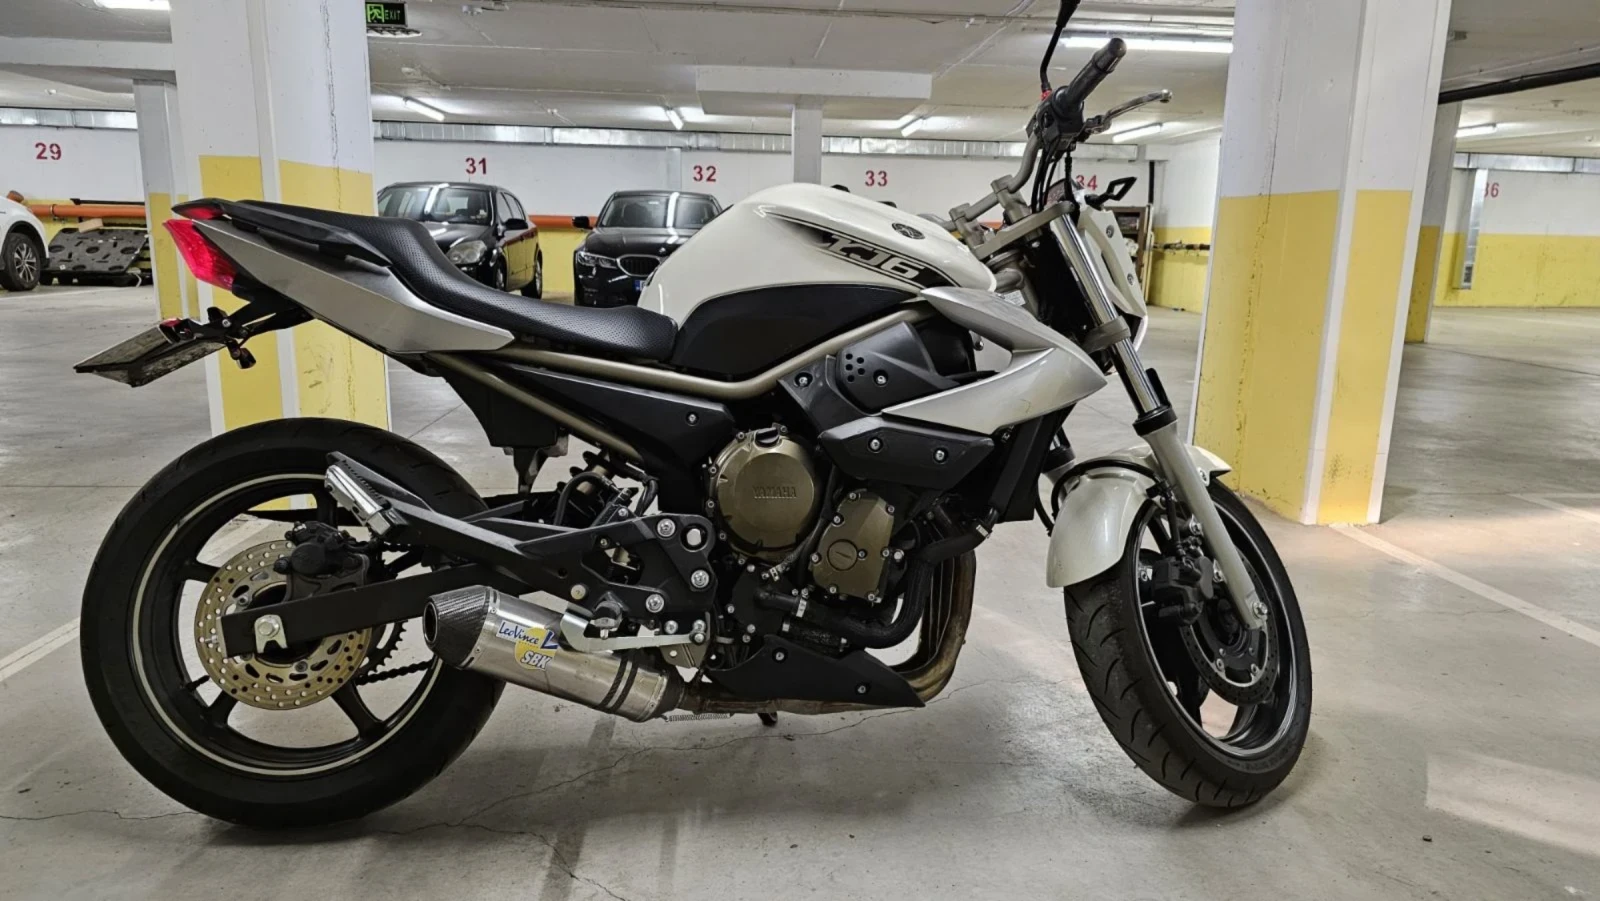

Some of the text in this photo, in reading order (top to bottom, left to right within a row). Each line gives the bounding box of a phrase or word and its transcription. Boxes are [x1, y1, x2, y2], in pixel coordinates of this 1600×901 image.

[384, 9, 401, 20] EXIT
[35, 142, 62, 160] 29
[465, 157, 487, 175] 31
[693, 165, 717, 182] 32
[865, 170, 888, 187] 33
[752, 485, 797, 499] YAMAHA
[499, 621, 539, 645] LeoVince
[520, 650, 552, 670] SBK
